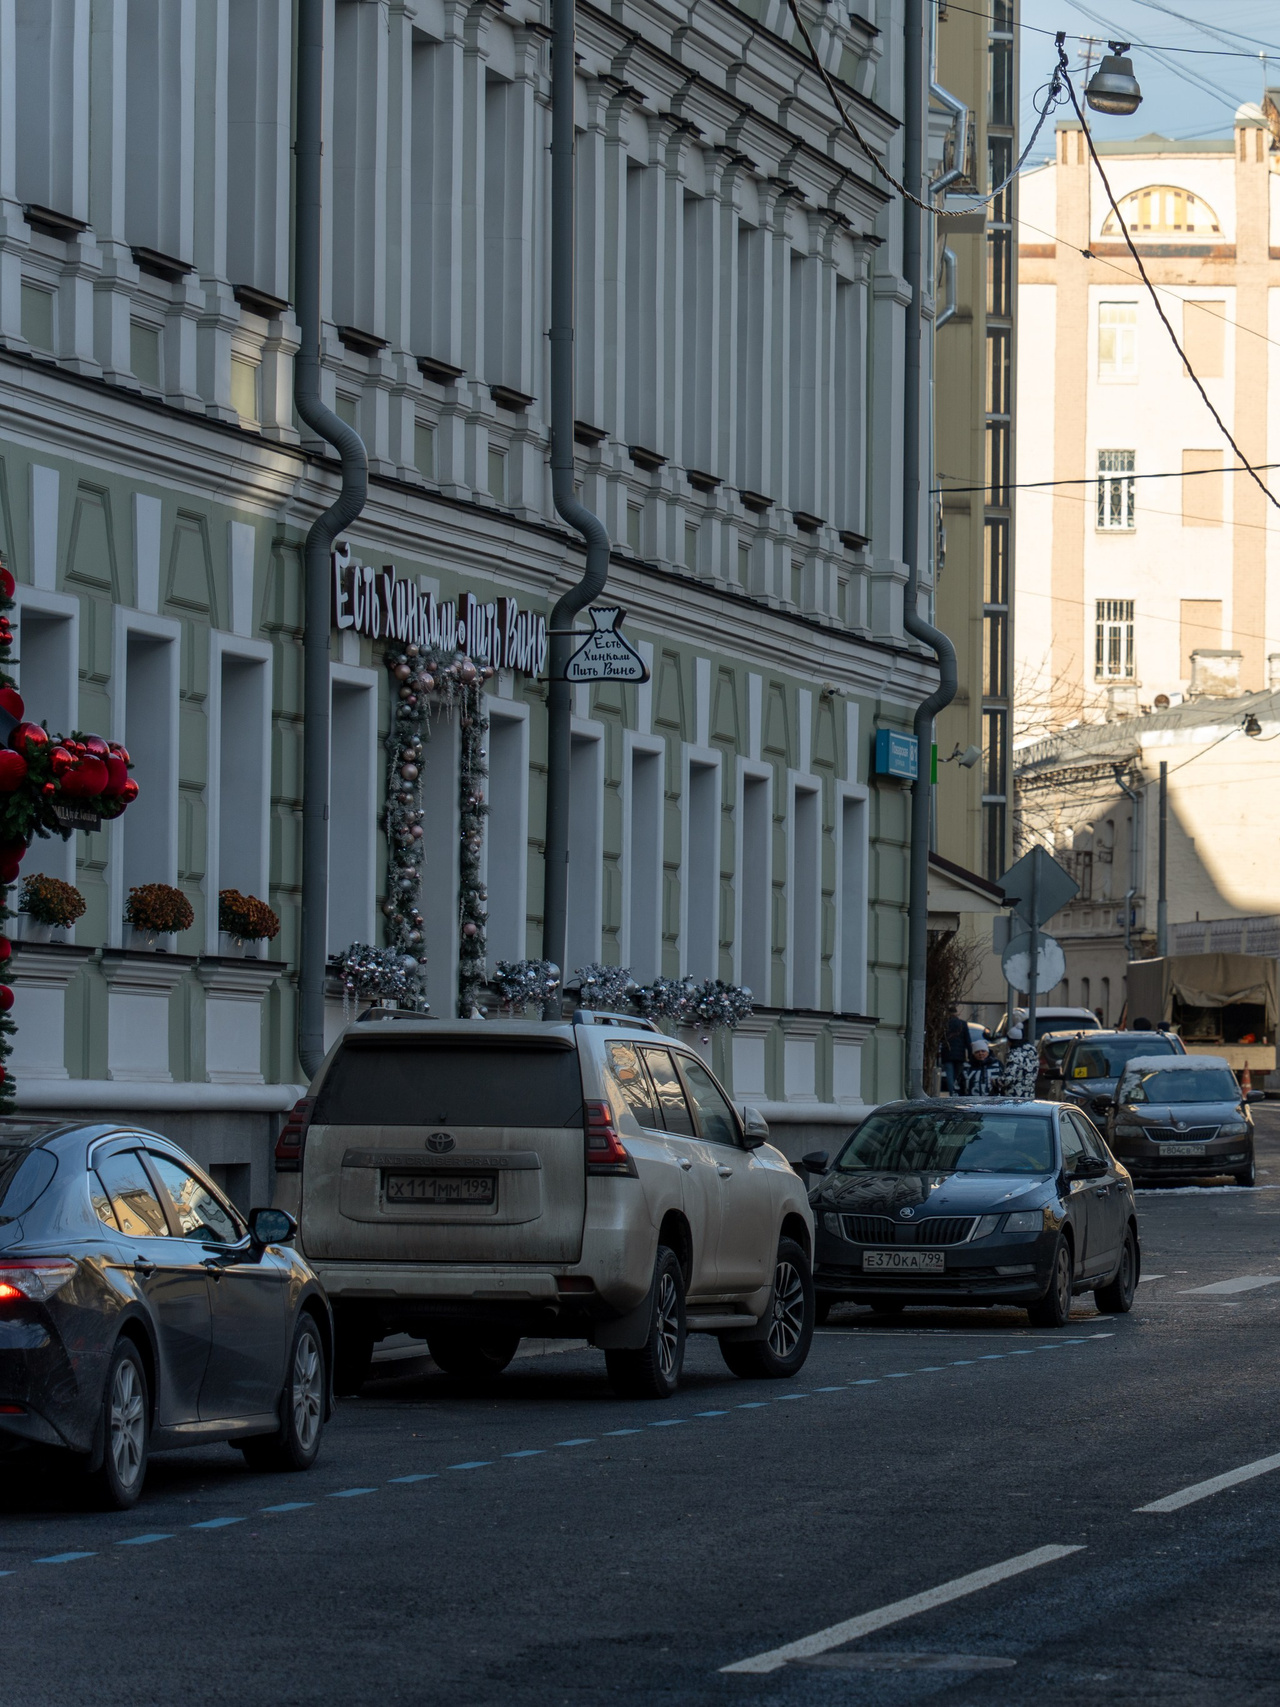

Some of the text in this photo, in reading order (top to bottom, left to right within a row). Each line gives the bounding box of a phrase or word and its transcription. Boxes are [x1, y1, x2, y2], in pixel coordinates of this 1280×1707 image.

[334, 541, 548, 679] Есть Хинкали Пить Вино
[594, 635, 622, 649] Есть
[584, 649, 631, 662] Хинкали
[573, 661, 636, 676] Пить Вино
[369, 1156, 509, 1167] LAND CRUISER PRADO
[463, 1180, 489, 1193] 199
[921, 1253, 941, 1263] 799
